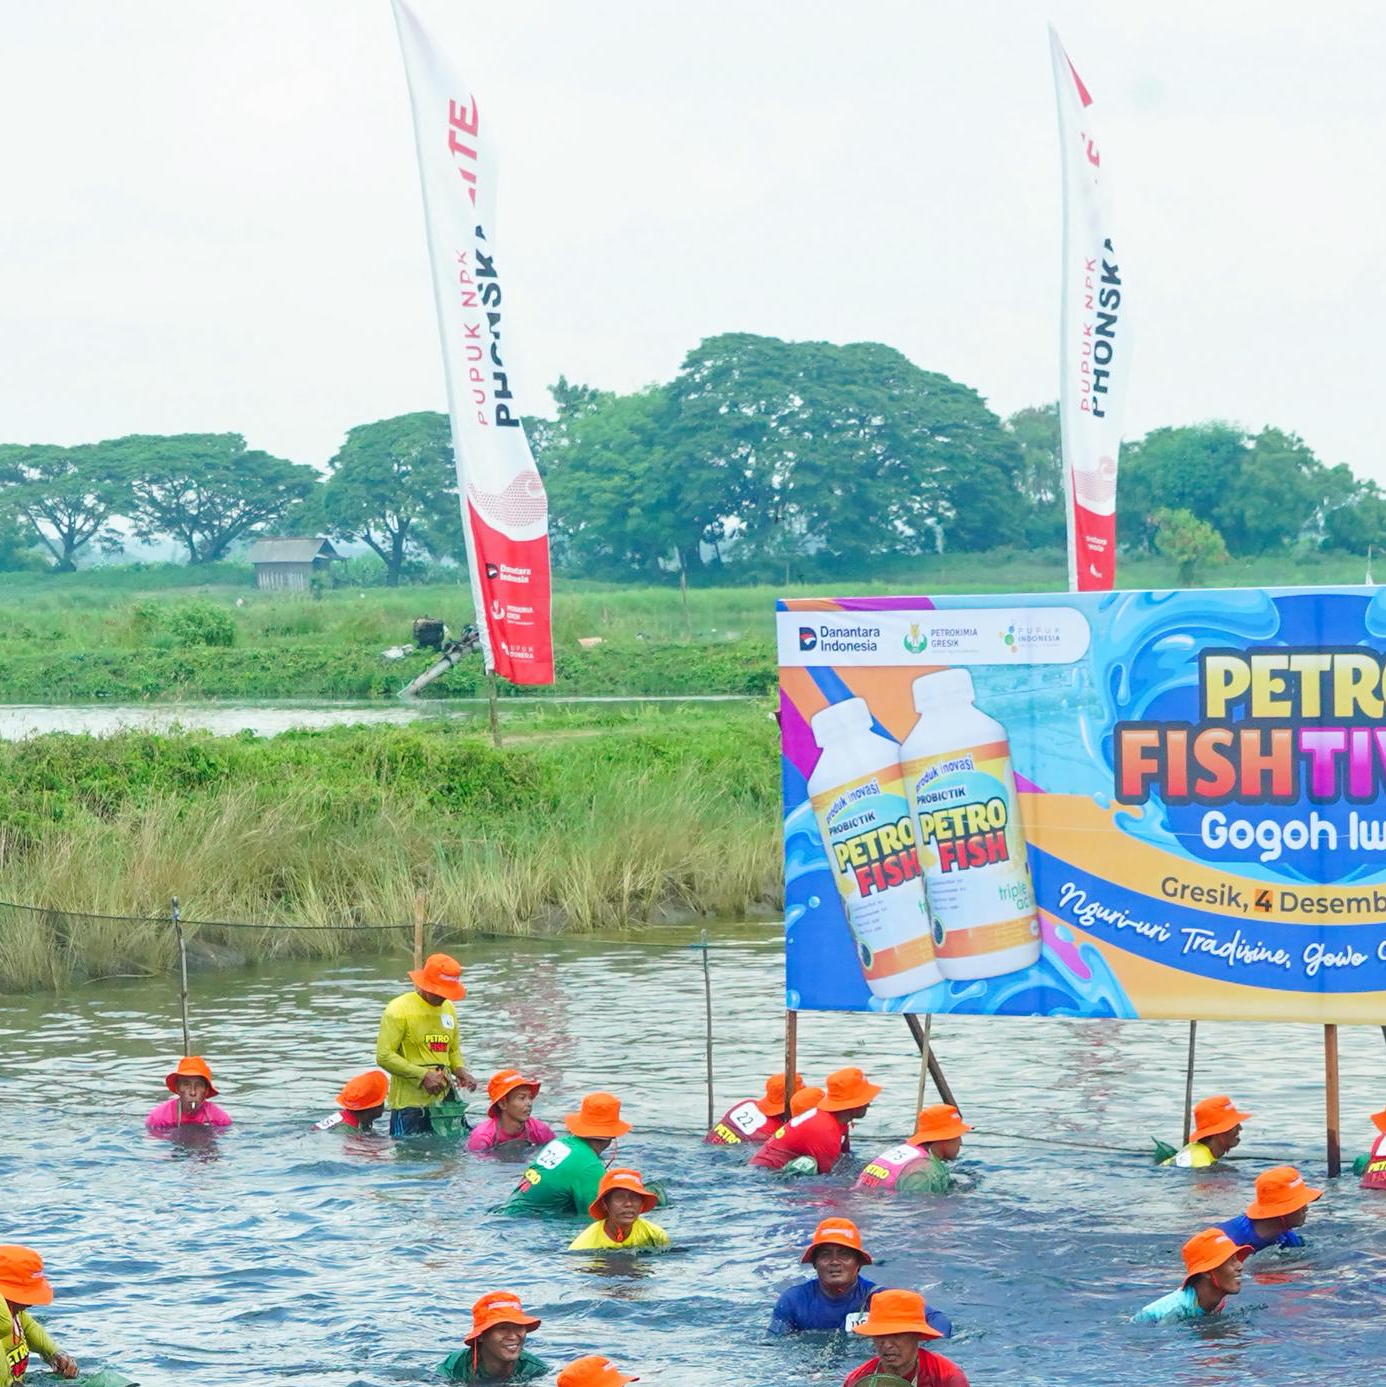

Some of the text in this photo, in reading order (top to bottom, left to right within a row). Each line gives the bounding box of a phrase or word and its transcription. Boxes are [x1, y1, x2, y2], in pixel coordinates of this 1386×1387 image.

[457, 249, 489, 426] PUPUK NPK
[820, 625, 881, 639] Danantara
[930, 628, 979, 638] PETROKIMIA
[930, 639, 960, 649] GRESIK
[1017, 634, 1061, 643] INDONESIA
[820, 639, 878, 653] Indonesia
[915, 753, 975, 792] produk inovasi
[826, 779, 881, 825] produk inovasi
[916, 786, 967, 806] PROBIOTIK
[828, 812, 876, 837] PROBIOTIK
[919, 796, 1007, 846] PETRO
[833, 816, 915, 873] PETRO
[1201, 810, 1338, 863] Gogoh
[938, 831, 1010, 873] FISH
[855, 848, 922, 898] FISH
[998, 882, 1028, 902] triple
[1161, 876, 1249, 913] Gresik,
[1254, 890, 1274, 912] 4
[1057, 882, 1172, 942] Nguri-uri
[1302, 942, 1369, 976] Gowo
[426, 1034, 451, 1044] PETRO
[736, 1111, 754, 1128] 22
[540, 1150, 557, 1167] 224
